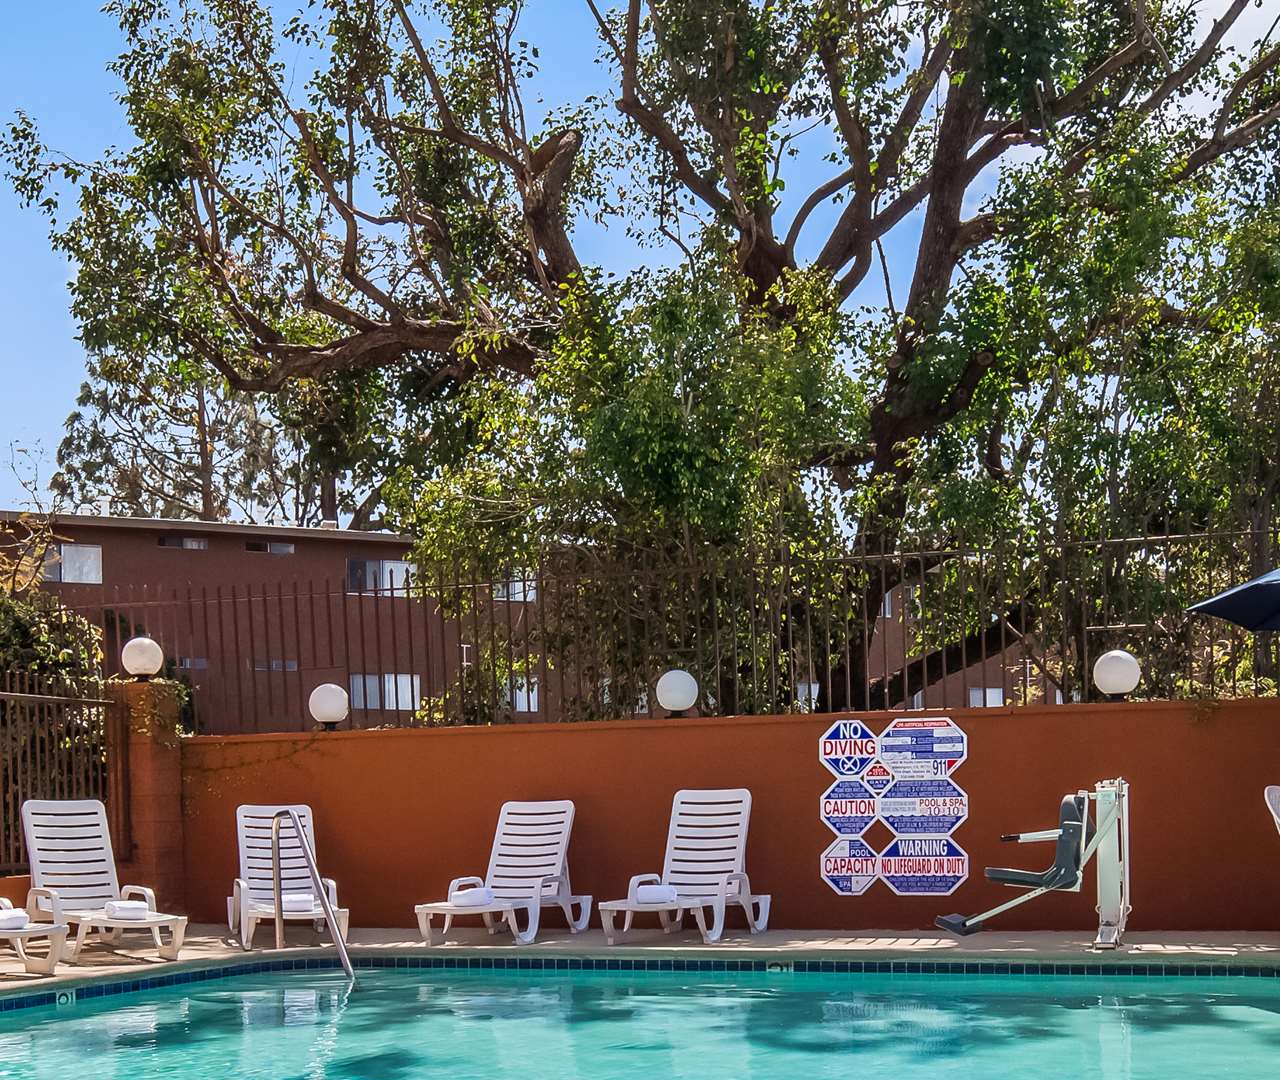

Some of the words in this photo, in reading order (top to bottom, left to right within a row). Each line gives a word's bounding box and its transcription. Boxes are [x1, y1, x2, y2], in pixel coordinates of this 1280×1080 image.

[840, 723, 861, 739] NO
[824, 740, 876, 755] DIVING
[932, 759, 947, 775] 911
[824, 800, 875, 815] CAUTION
[919, 799, 940, 807] POOL
[928, 806, 940, 816] 10
[947, 806, 960, 816] 10
[850, 849, 871, 857] POOL
[898, 840, 948, 856] WARNING
[824, 858, 877, 874] CAPACITY
[882, 858, 892, 874] NO
[894, 858, 932, 874] LIFEGUARD
[934, 858, 945, 874] ON
[946, 858, 965, 874] DUTY
